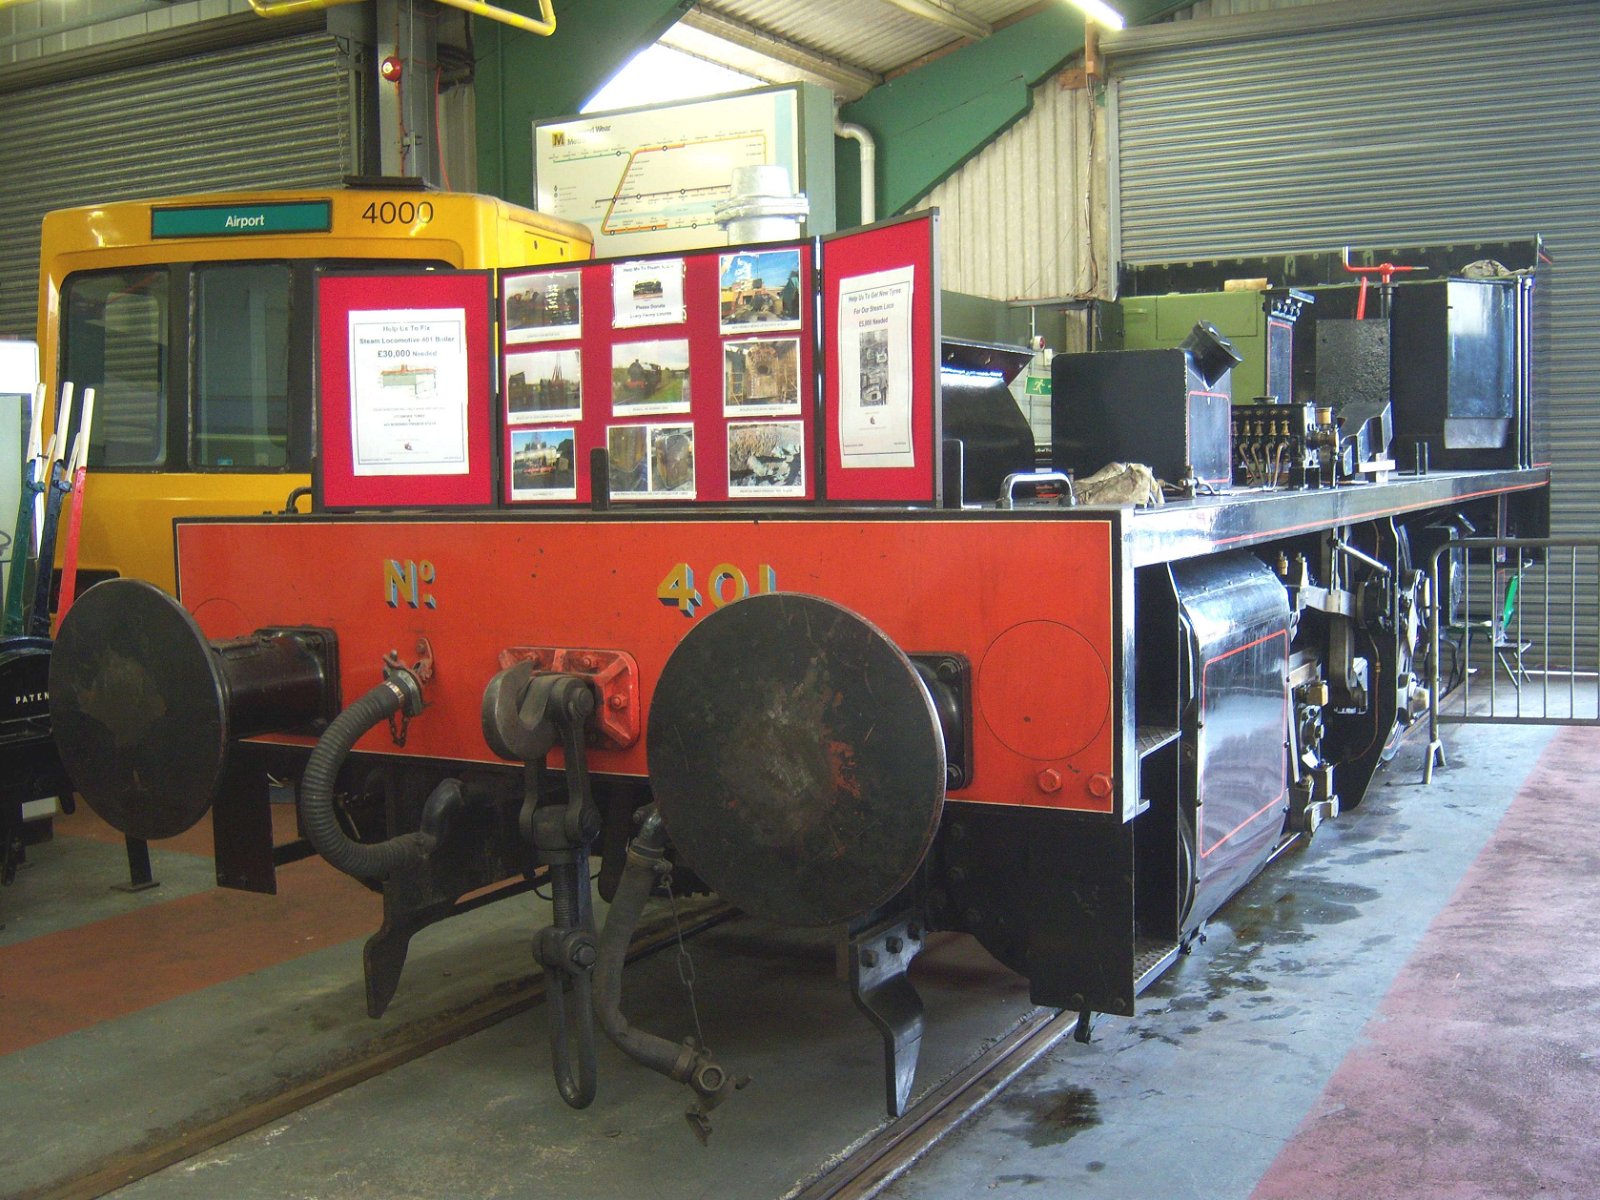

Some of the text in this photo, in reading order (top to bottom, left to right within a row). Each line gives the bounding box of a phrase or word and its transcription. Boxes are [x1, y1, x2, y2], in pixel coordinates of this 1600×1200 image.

[553, 132, 565, 146] M
[361, 201, 434, 224] 4000
[225, 215, 265, 229] Airport
[382, 325, 399, 333] Help
[377, 349, 411, 359] £30,000
[657, 562, 777, 618] 401
